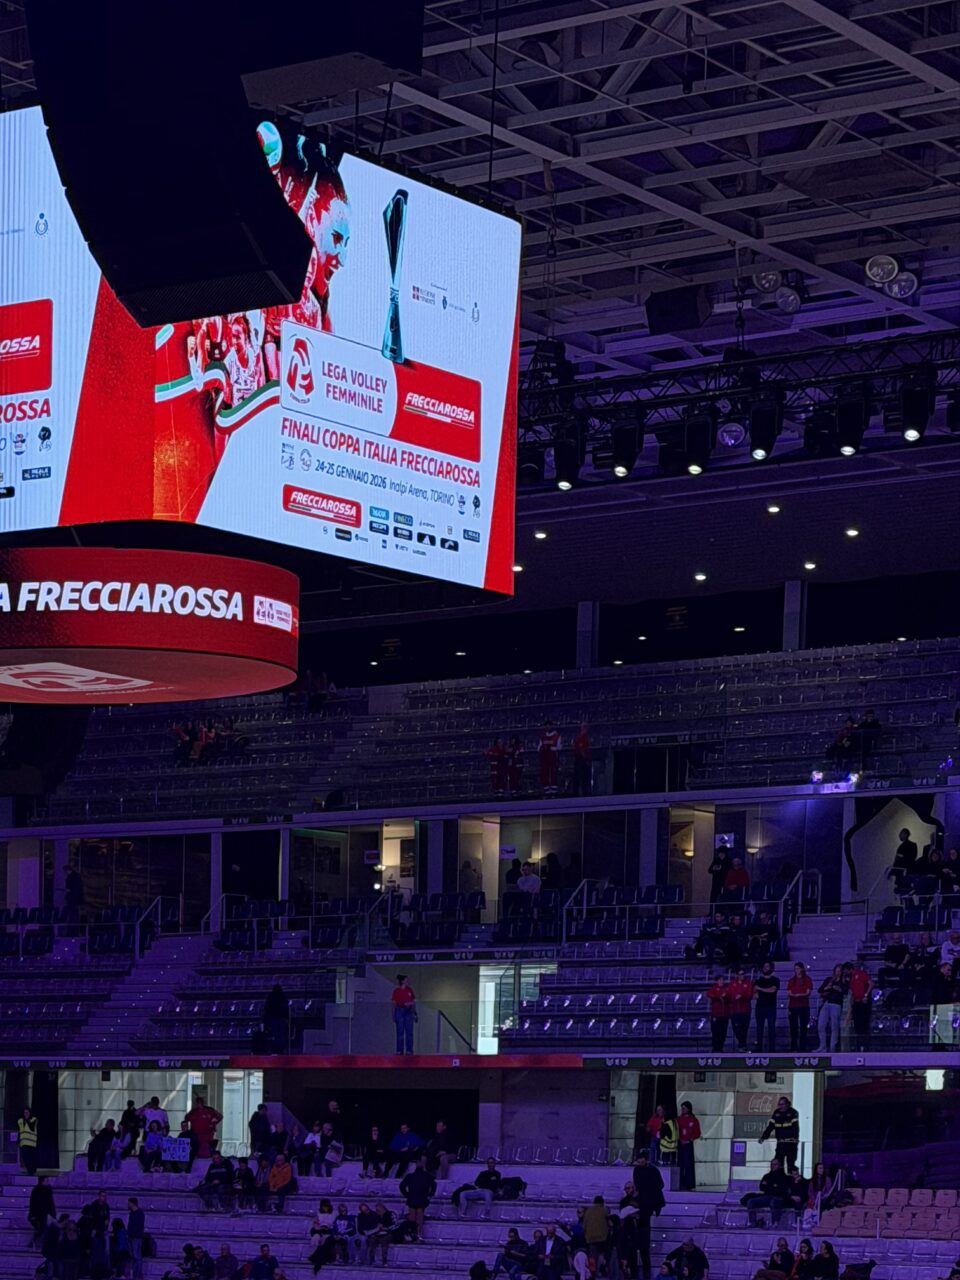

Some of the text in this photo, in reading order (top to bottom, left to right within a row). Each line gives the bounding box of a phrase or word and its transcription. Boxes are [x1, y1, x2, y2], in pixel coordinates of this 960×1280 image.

[322, 361, 387, 394] LEGA VOLLEY
[326, 383, 383, 413] FEMMINILE
[405, 392, 474, 423] FRECCIAROSSA
[281, 417, 480, 488] FINALI COPPA ITALIA FRECCIAROSSA
[315, 459, 455, 507] 24-25 GENNAIO 2026 Inalpi Arena, TORINO
[290, 491, 356, 517] FRECCIAROSSA
[17, 581, 243, 621] FRECCIAROSSA
